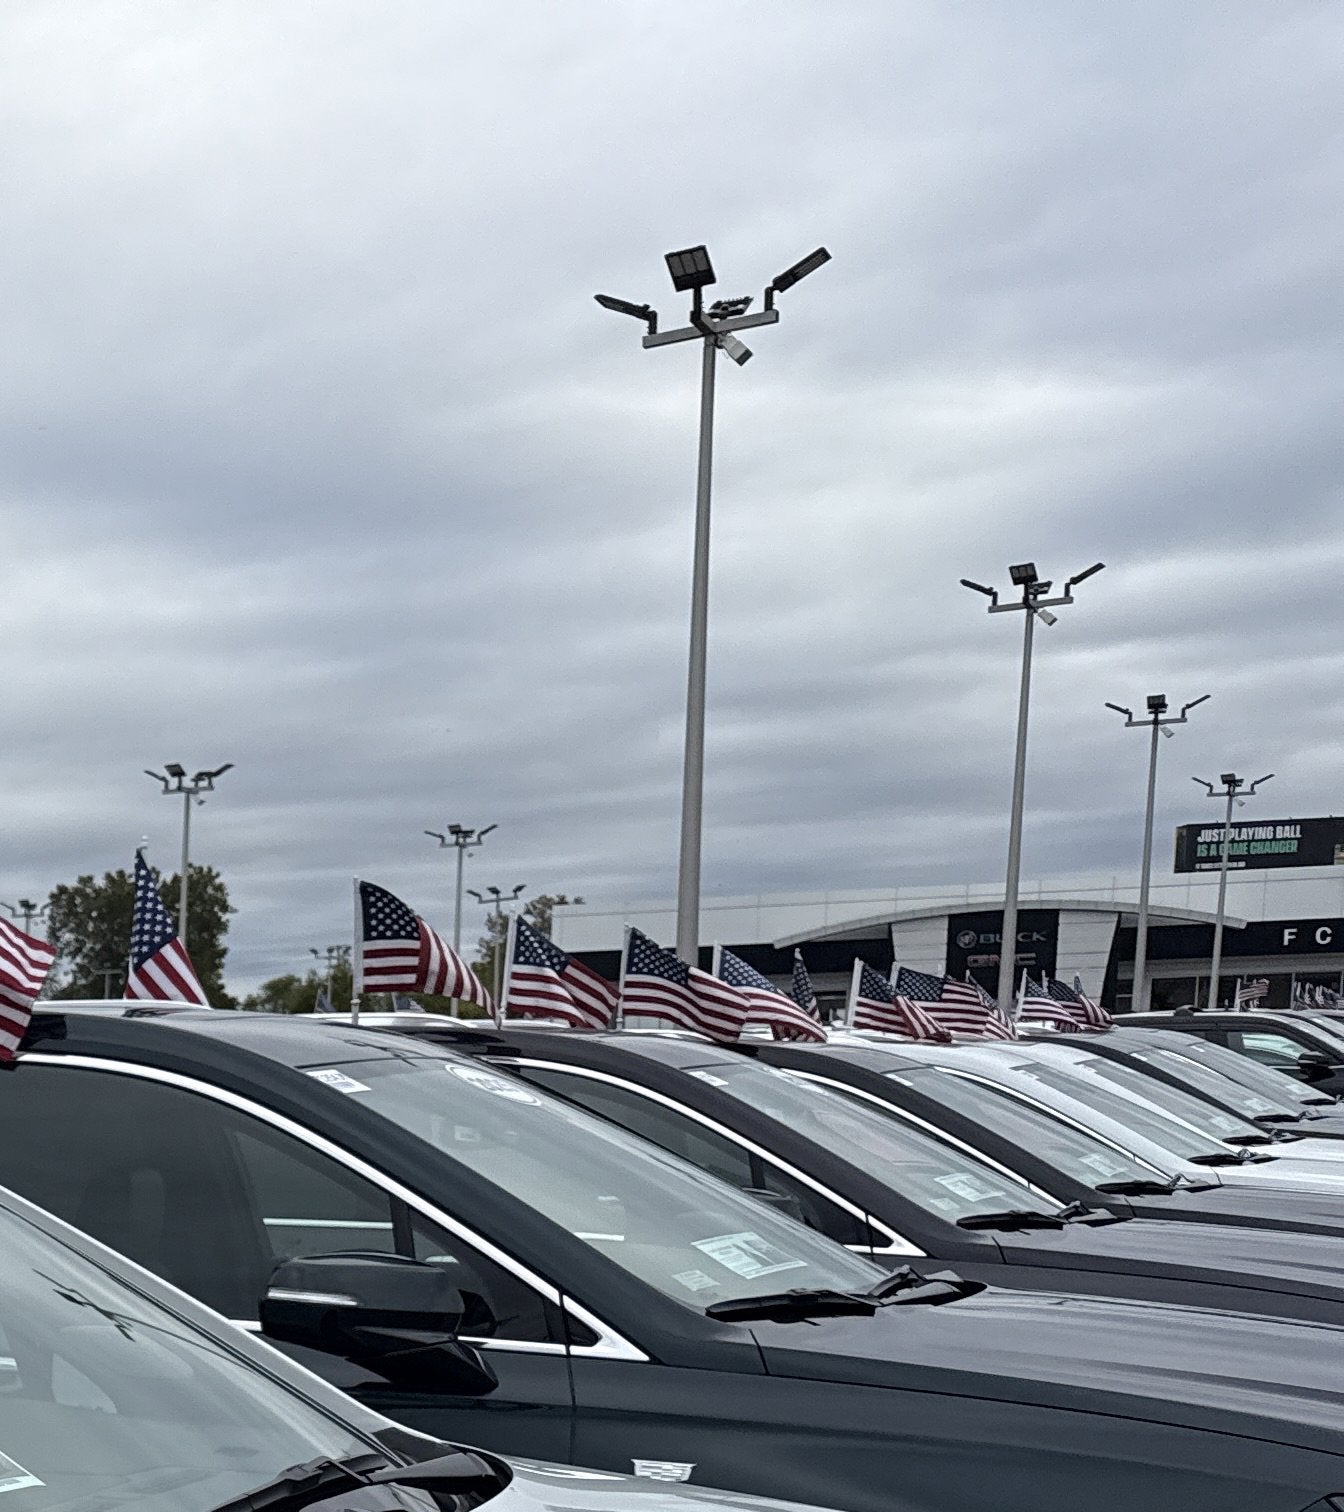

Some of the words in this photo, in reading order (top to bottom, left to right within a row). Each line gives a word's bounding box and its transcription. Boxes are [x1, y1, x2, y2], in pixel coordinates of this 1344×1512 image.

[1197, 829, 1226, 843] JUST
[1227, 826, 1274, 841] PLAYING
[1275, 824, 1302, 839] BALL
[1196, 843, 1208, 857] IS
[1209, 843, 1217, 856] A
[1249, 839, 1299, 855] CHANGER
[1283, 927, 1299, 946] F
[1315, 926, 1333, 945] C
